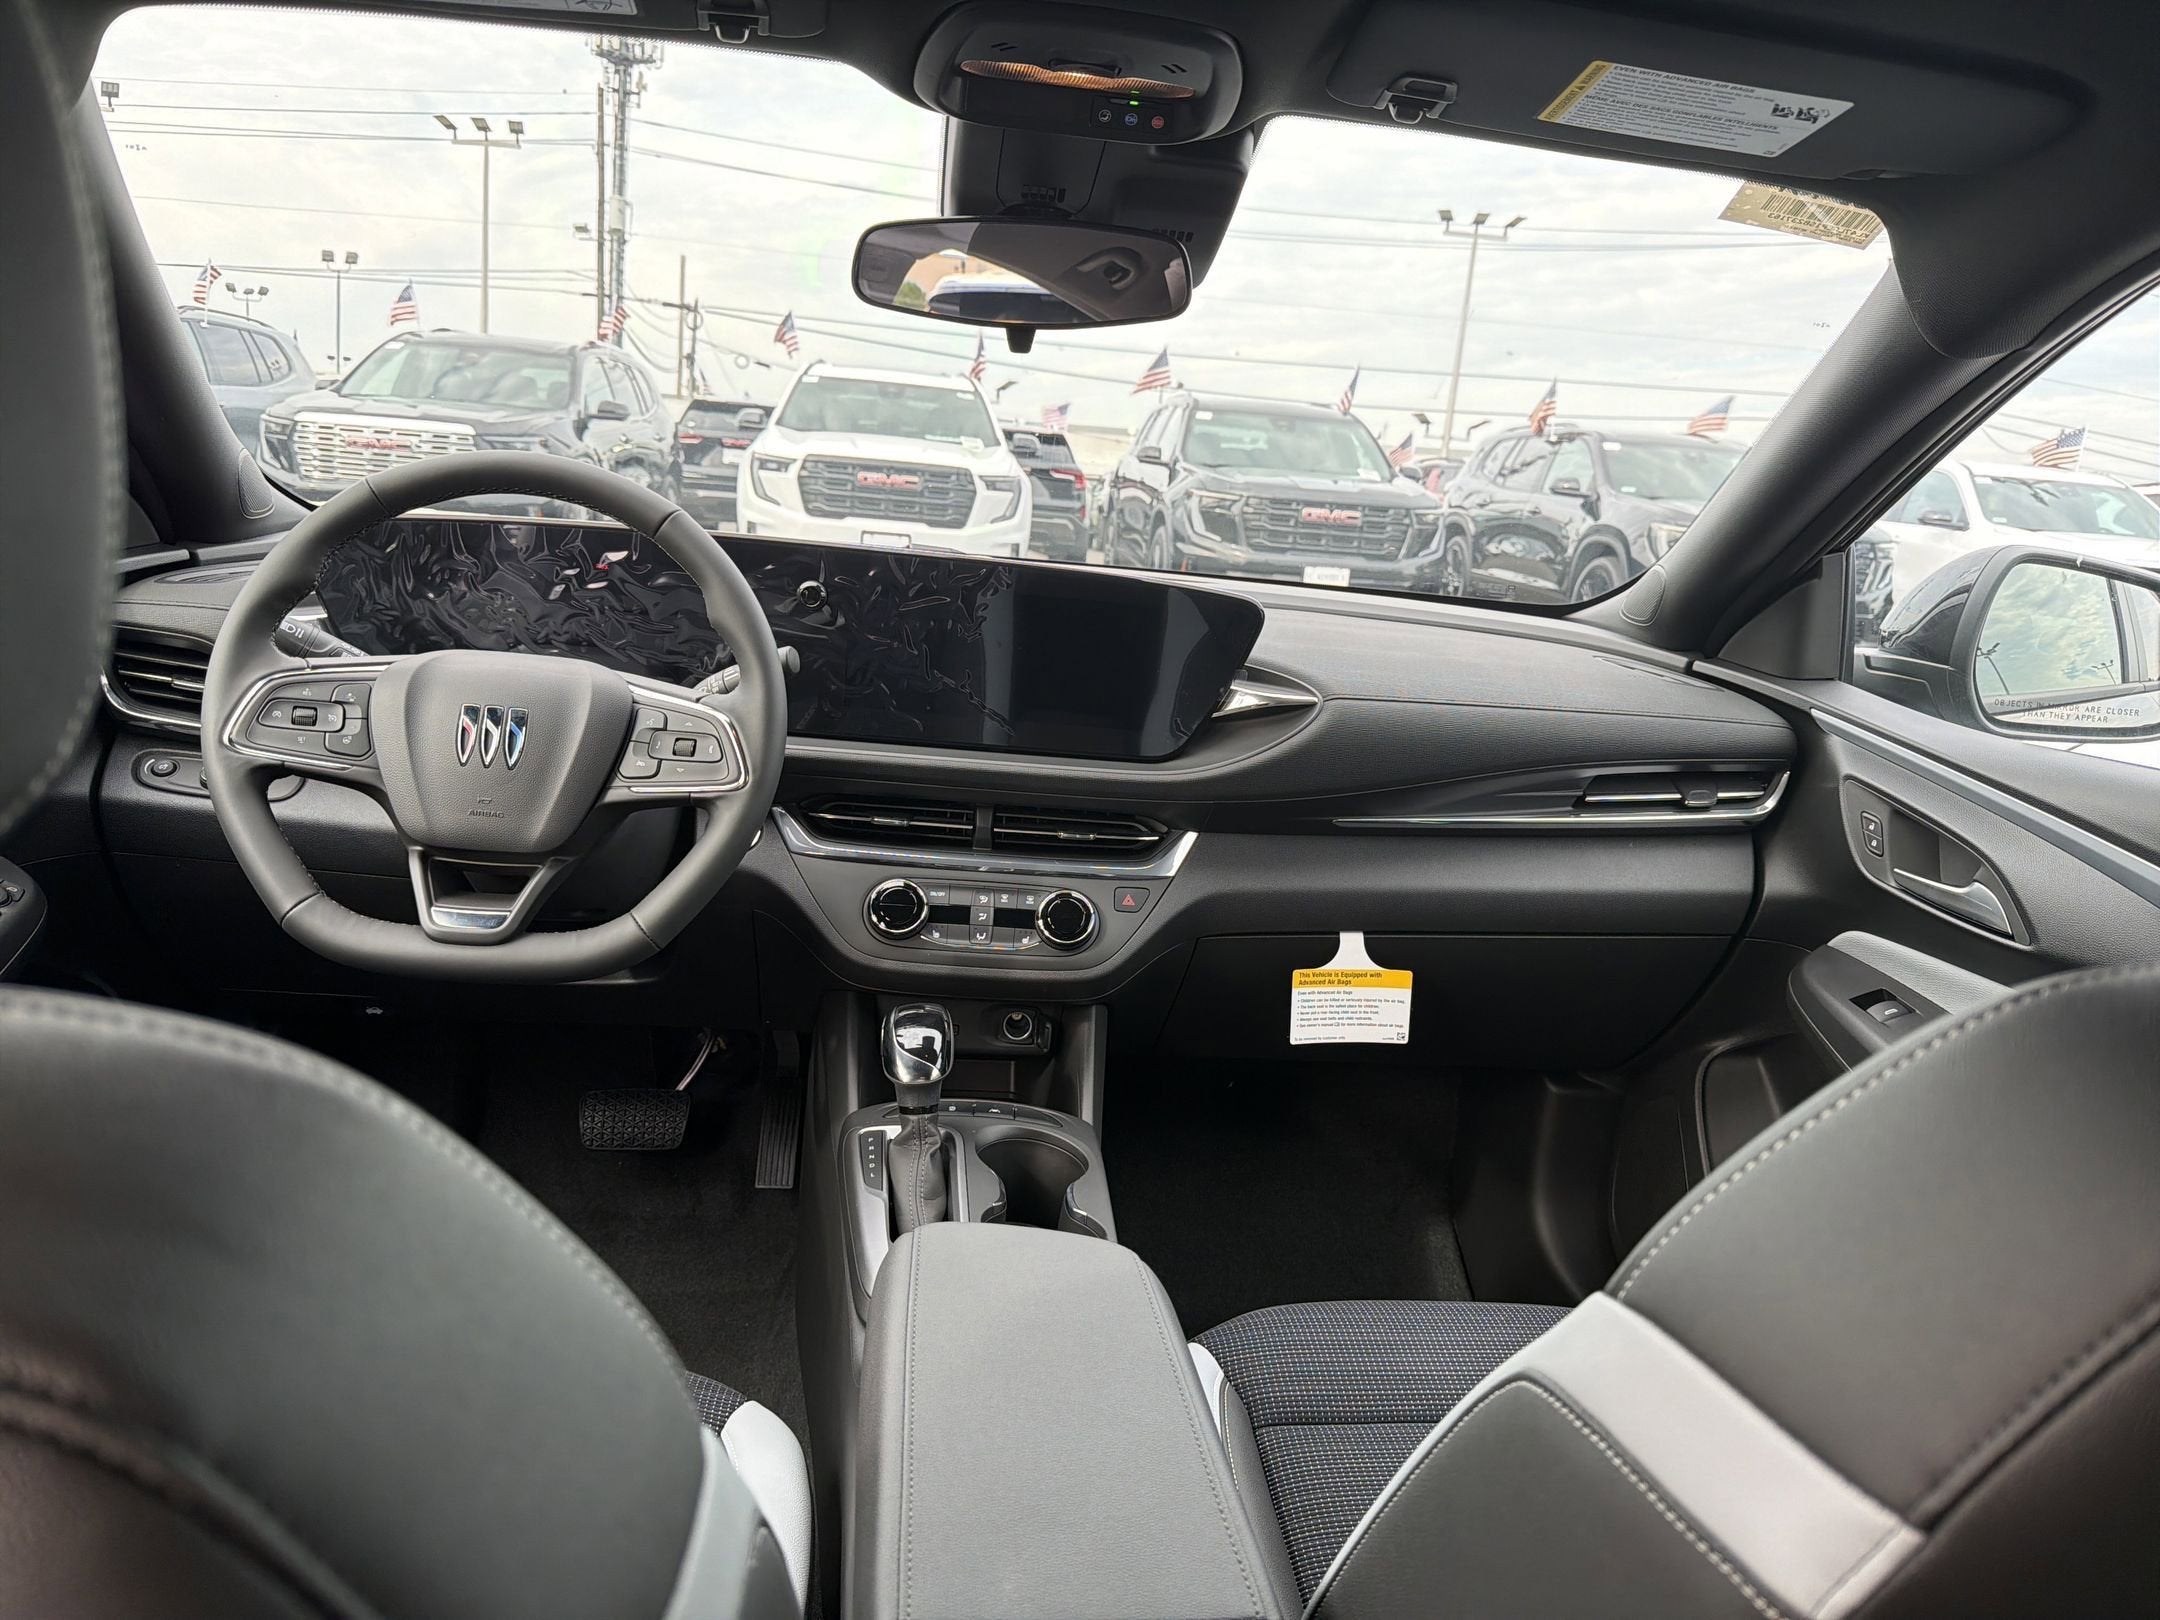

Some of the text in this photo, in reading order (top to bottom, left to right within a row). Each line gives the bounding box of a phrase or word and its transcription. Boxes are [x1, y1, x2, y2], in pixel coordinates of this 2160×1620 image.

[1613, 65, 1757, 94] EVEN WITH ADVANCED AIR BAGS
[857, 471, 921, 490] GMC
[1302, 507, 1361, 526] GMC
[1994, 698, 2033, 708] OBJECTS
[2048, 703, 2080, 712] MIRROR
[2085, 706, 2101, 714] ARE
[2106, 707, 2140, 717] CLOSER
[2023, 710, 2109, 723] THAN THEY APPEAR
